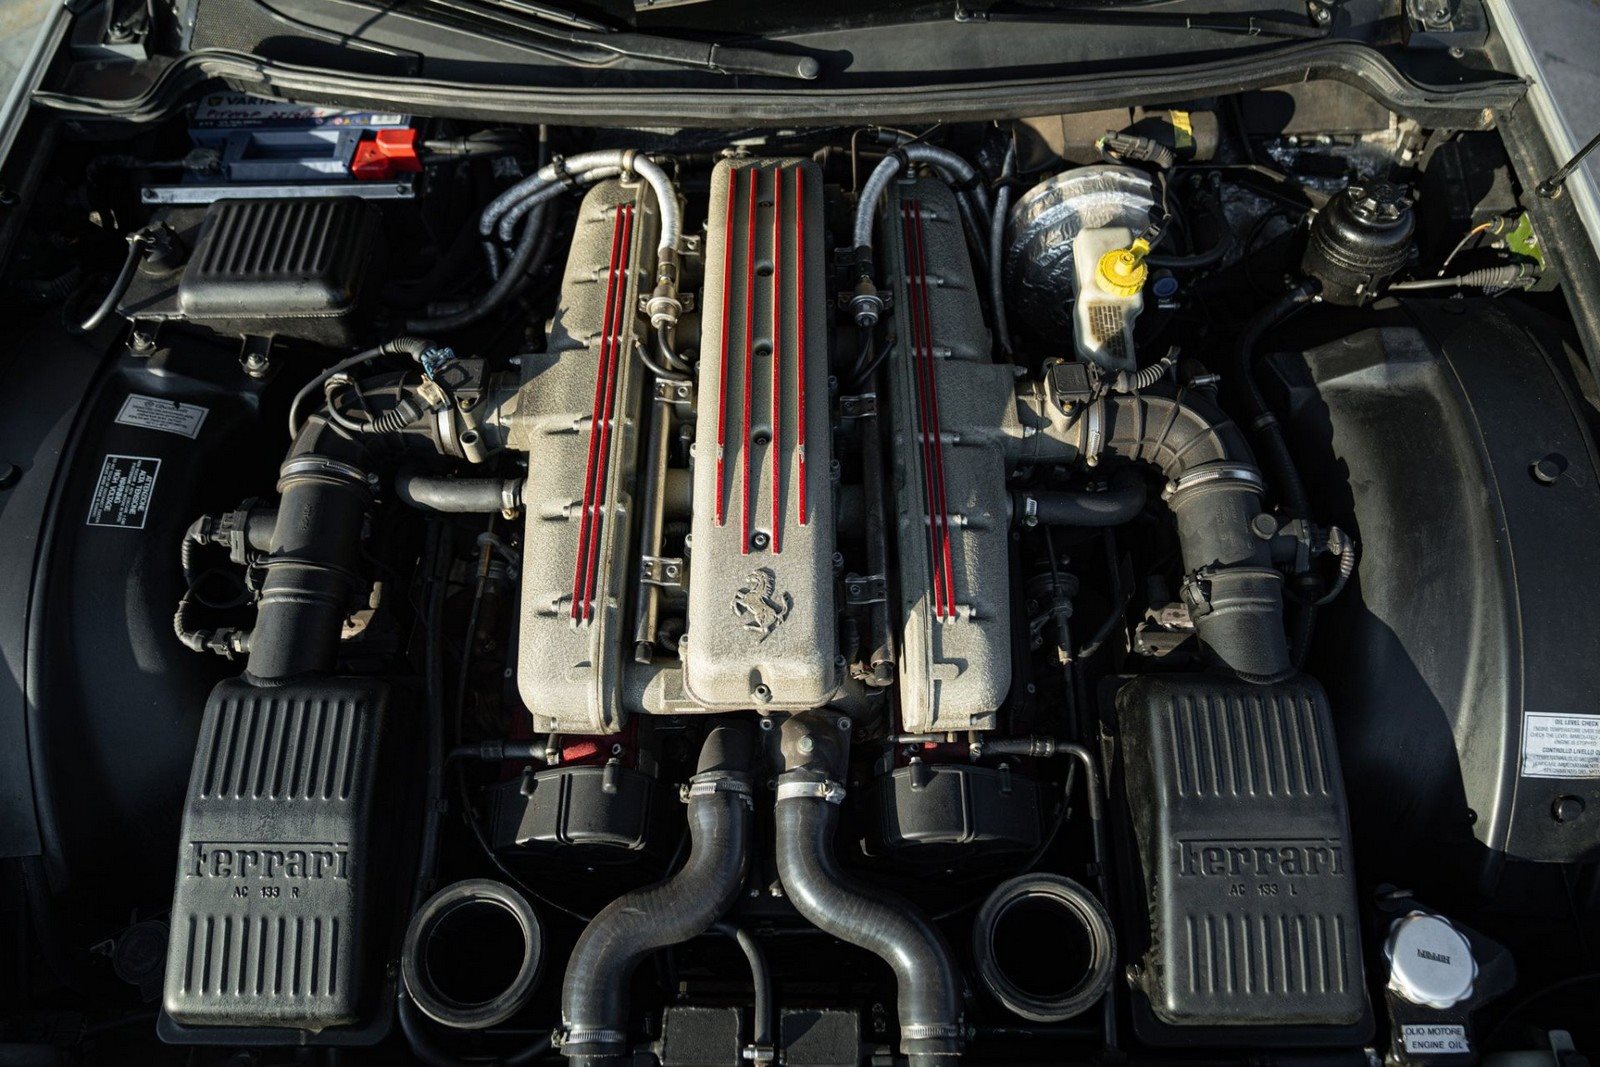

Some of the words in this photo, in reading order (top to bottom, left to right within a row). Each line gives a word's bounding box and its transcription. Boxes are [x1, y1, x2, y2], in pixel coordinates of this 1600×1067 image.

[112, 469, 121, 484] HIGH
[137, 470, 146, 484] ALTA
[104, 486, 117, 512] VOLTAGE
[114, 476, 127, 504] WARNING
[129, 485, 142, 514] TENSIONE
[187, 840, 348, 880] Ferrari
[1177, 838, 1345, 878] Ferrari
[232, 886, 249, 898] AC
[260, 886, 280, 898] 133
[290, 886, 300, 898] R
[1229, 884, 1246, 896] AC
[1290, 884, 1298, 896] L
[1406, 1028, 1425, 1036] OLIO
[1428, 1028, 1462, 1036] MOTORE
